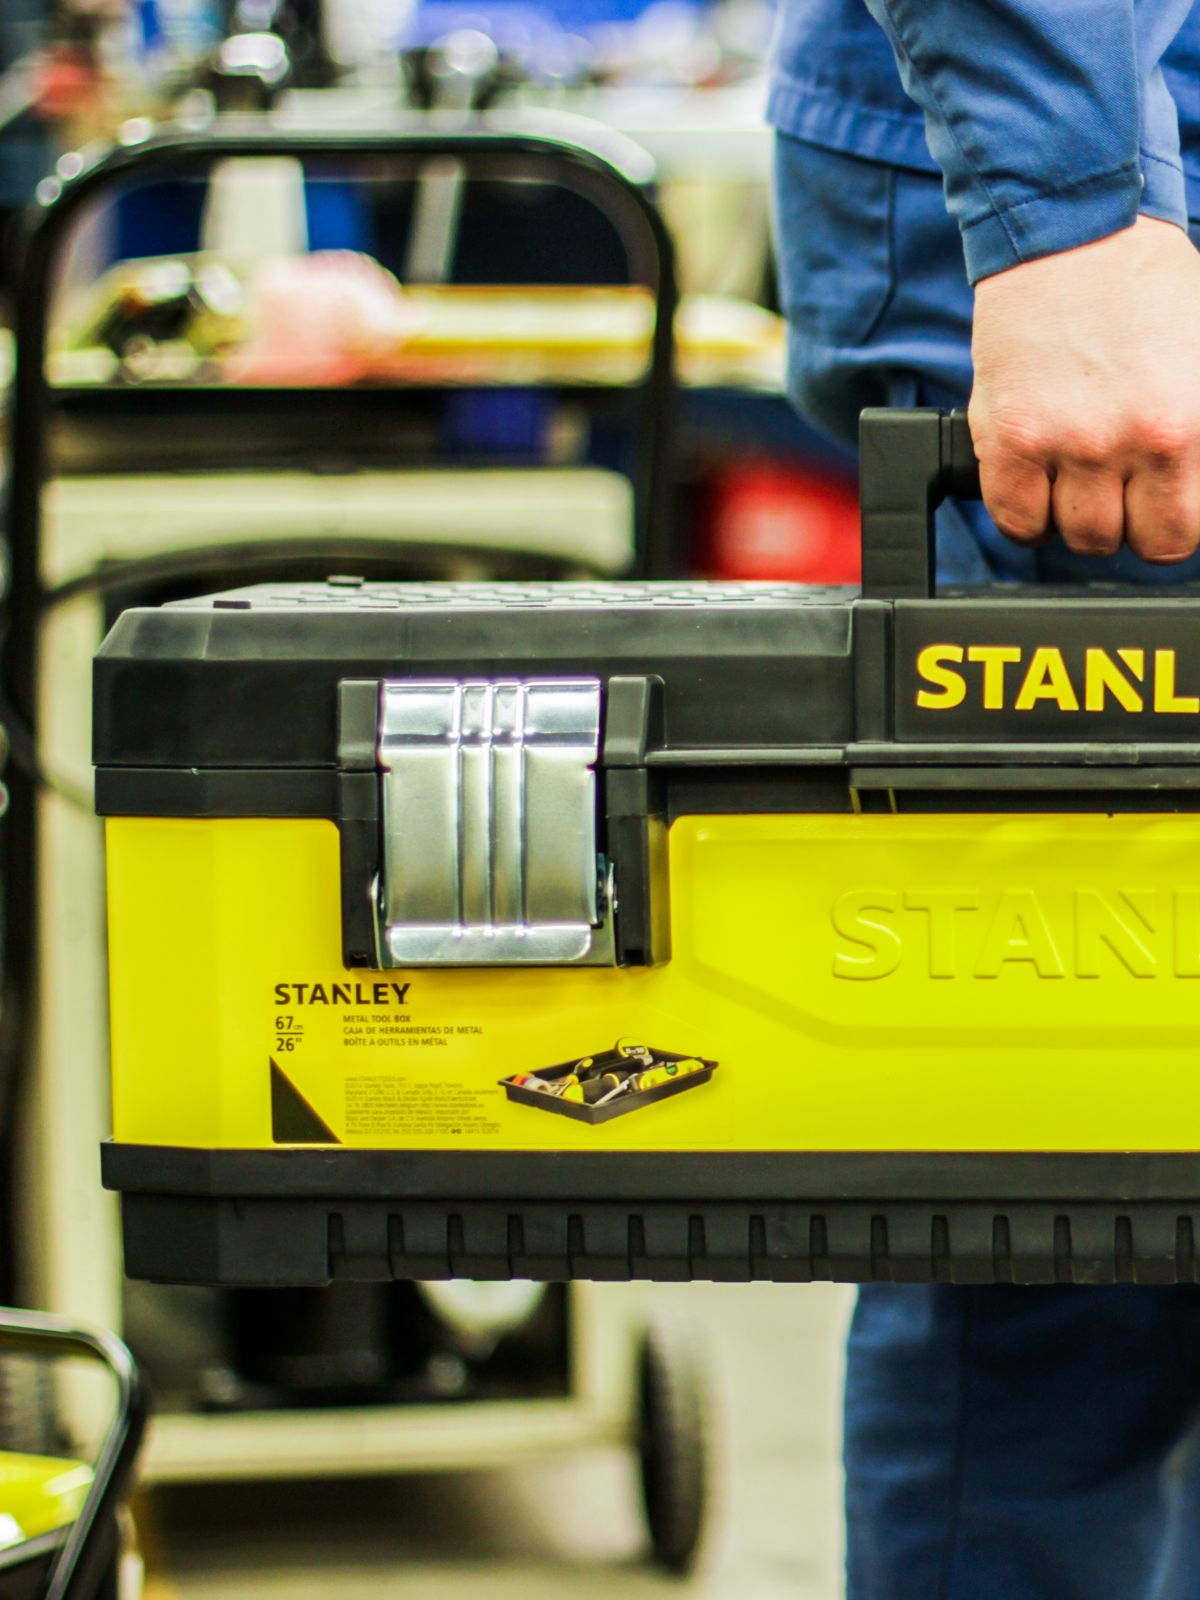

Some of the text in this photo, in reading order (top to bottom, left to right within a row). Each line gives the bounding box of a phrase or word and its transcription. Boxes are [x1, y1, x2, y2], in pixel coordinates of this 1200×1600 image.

[274, 983, 411, 1005] STANLEY
[343, 1015, 411, 1023] METAL TOOL BOX
[343, 1026, 483, 1035] CAJA DE HERRAMIENTAS DE METAL
[377, 1037, 406, 1046] OUTILS
[408, 1037, 419, 1046] EN
